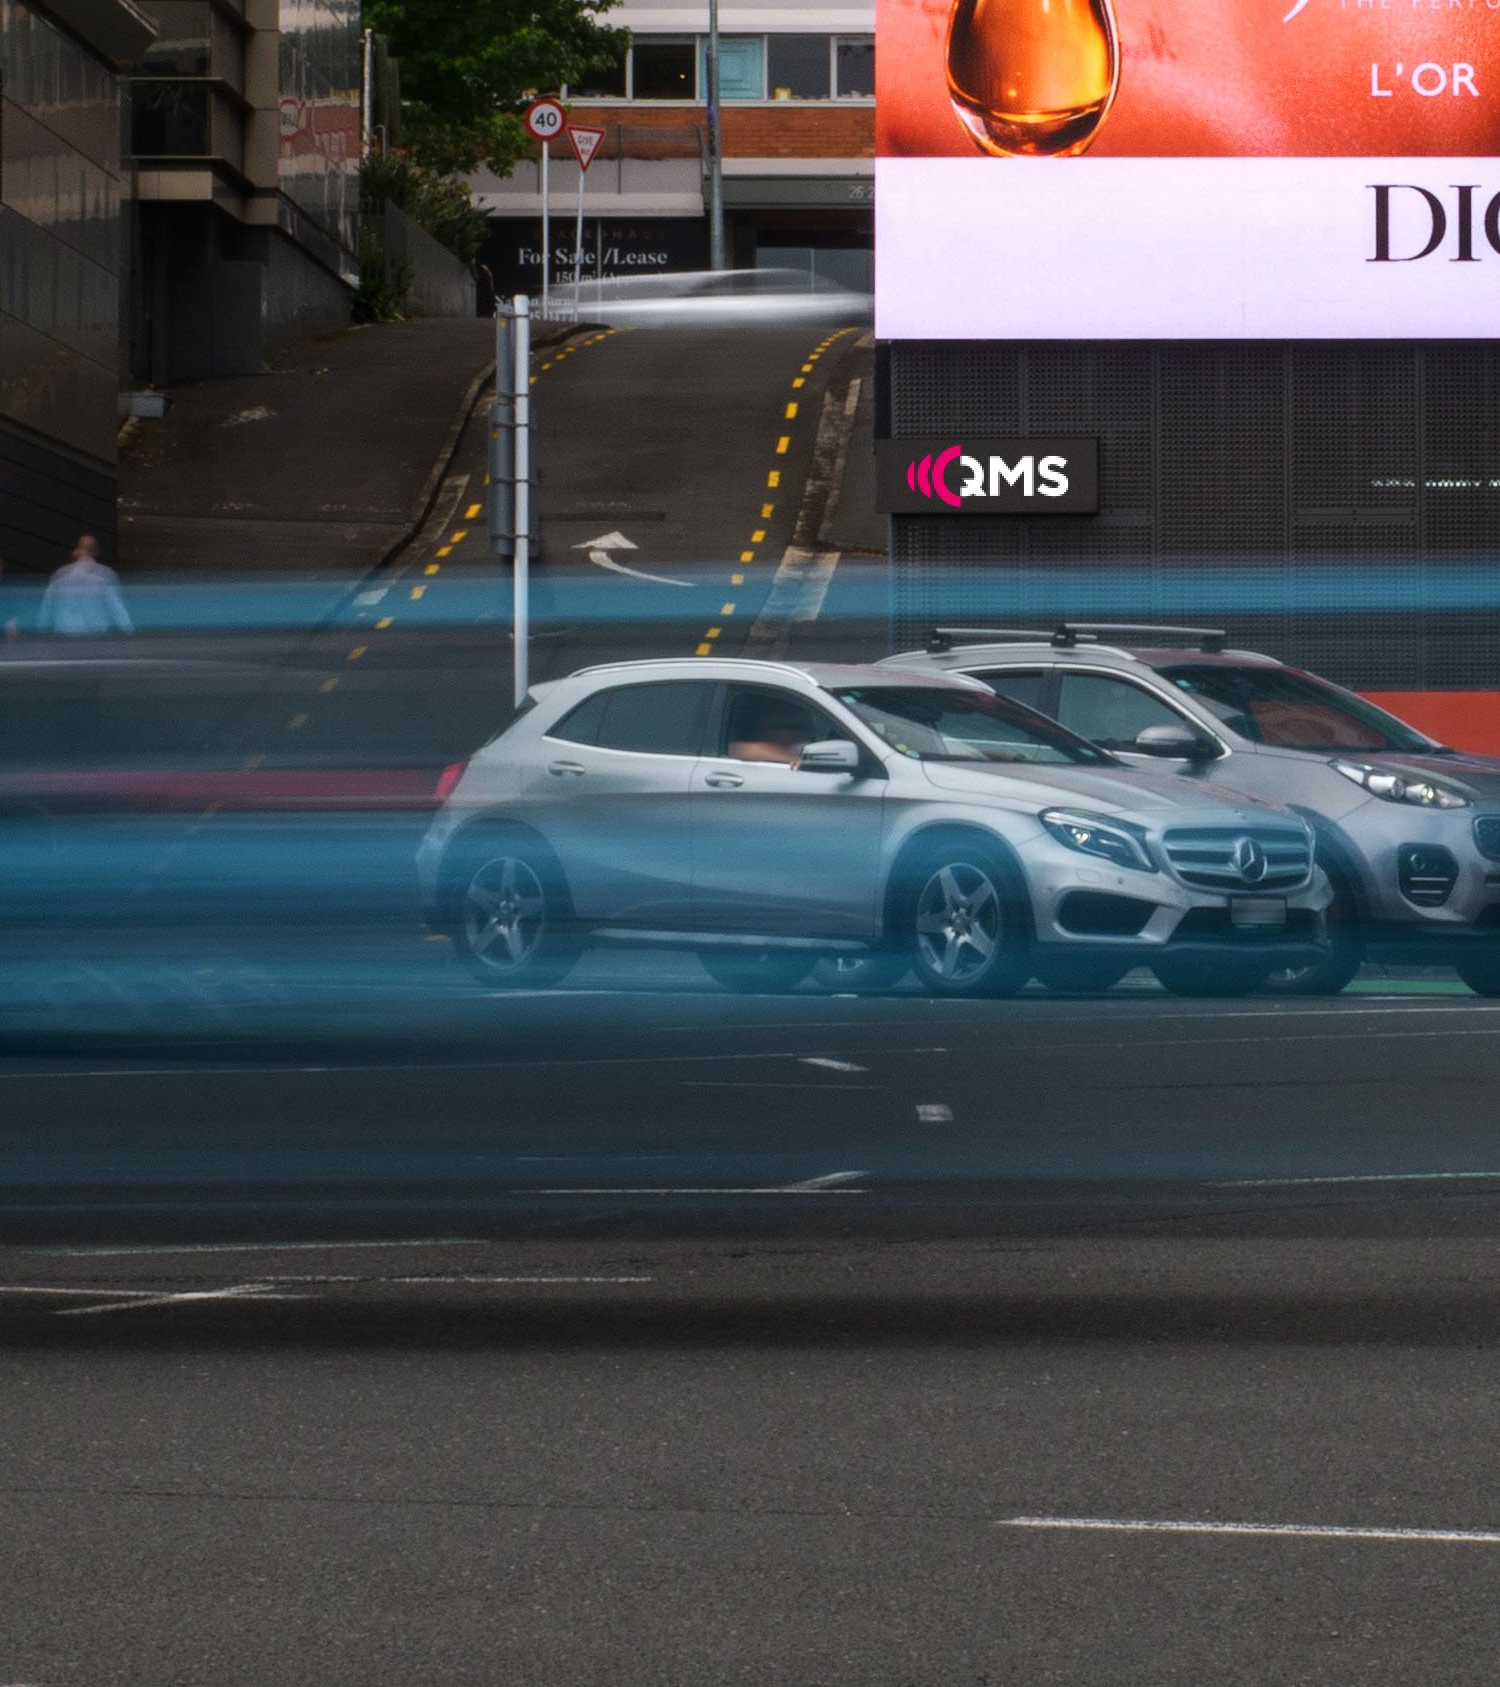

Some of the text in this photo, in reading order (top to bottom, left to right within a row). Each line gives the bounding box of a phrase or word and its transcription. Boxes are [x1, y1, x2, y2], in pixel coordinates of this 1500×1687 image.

[1371, 63, 1480, 97] L'OR
[535, 112, 557, 128] 40
[932, 448, 1069, 505] QMS
